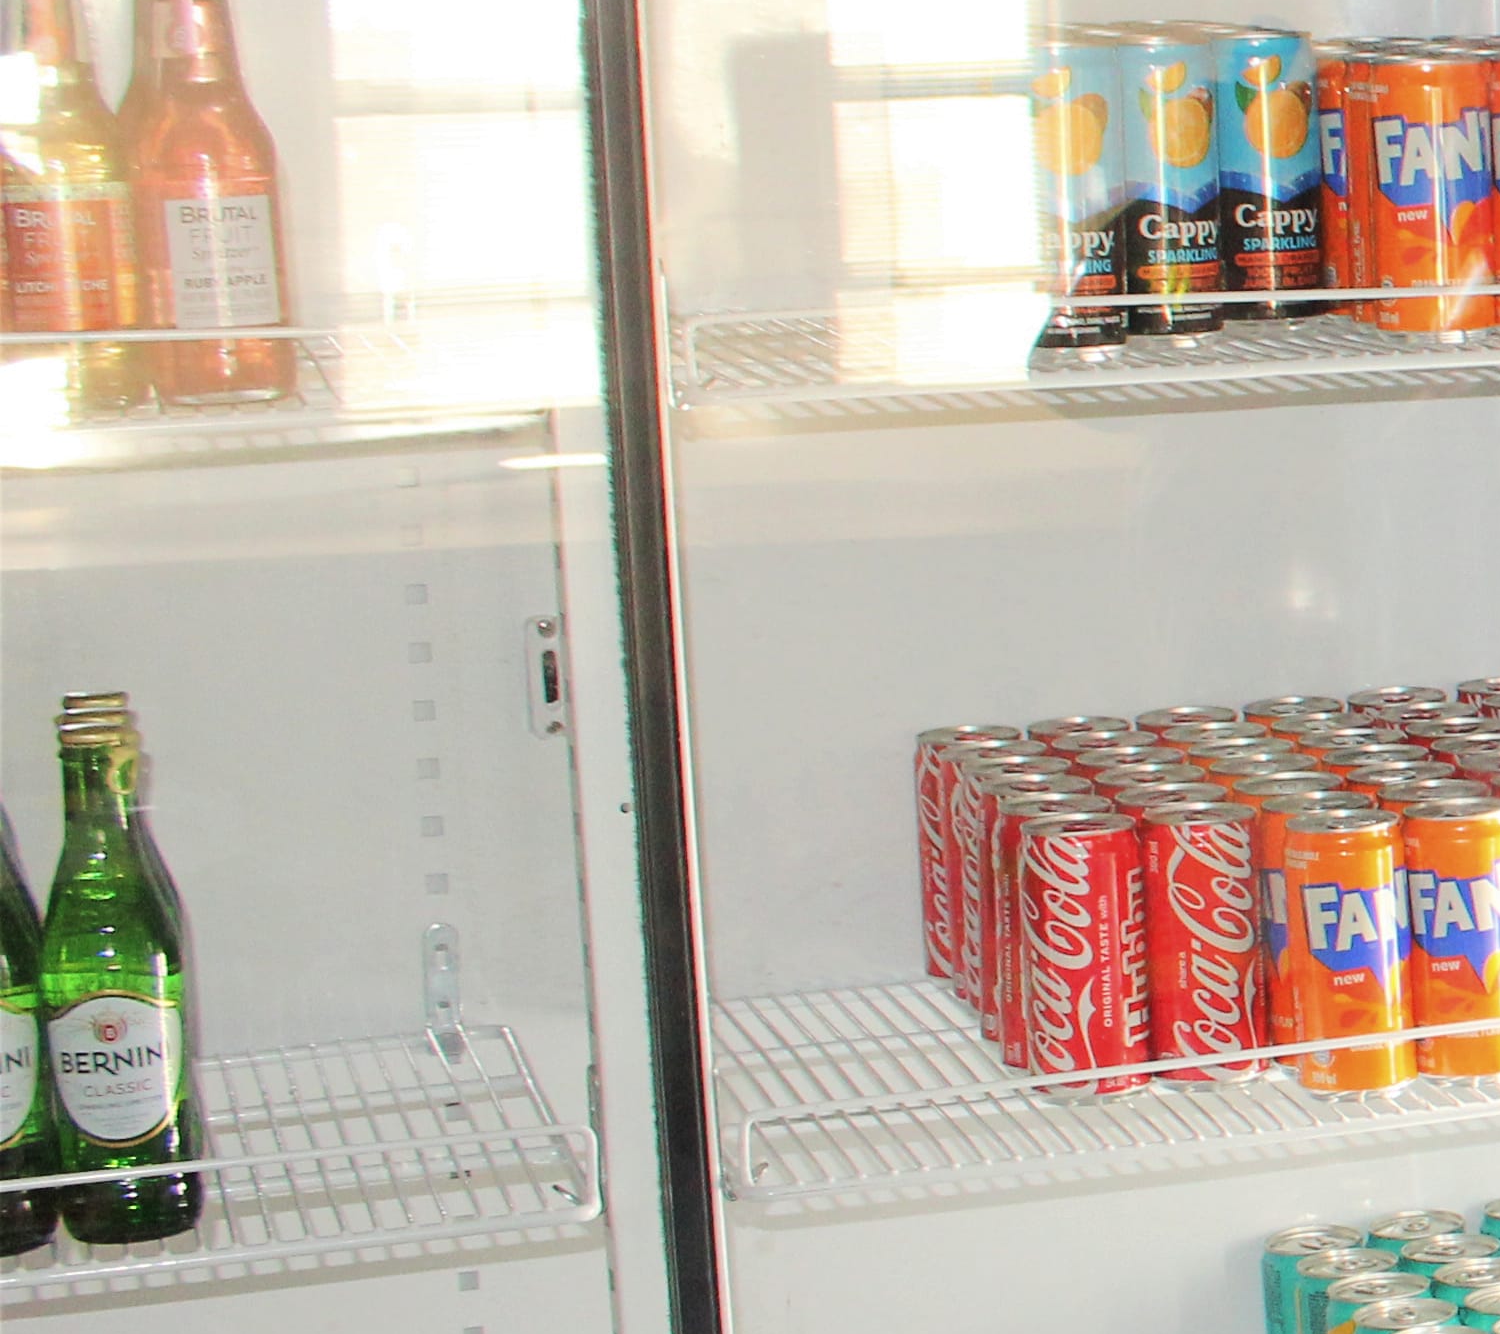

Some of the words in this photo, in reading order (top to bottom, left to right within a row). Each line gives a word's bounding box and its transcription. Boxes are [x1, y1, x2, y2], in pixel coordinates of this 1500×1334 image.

[1234, 204, 1318, 234] Cappy
[1397, 206, 1428, 222] new
[1139, 214, 1219, 247] Cappy
[1243, 234, 1317, 252] SPARKLING
[1099, 894, 1109, 920] with
[1102, 924, 1114, 966] TASTE
[1431, 958, 1462, 973] new
[1333, 971, 1366, 987] new
[1103, 968, 1115, 1028] ORIGINAL
[83, 1078, 153, 1098] CLASSIC
